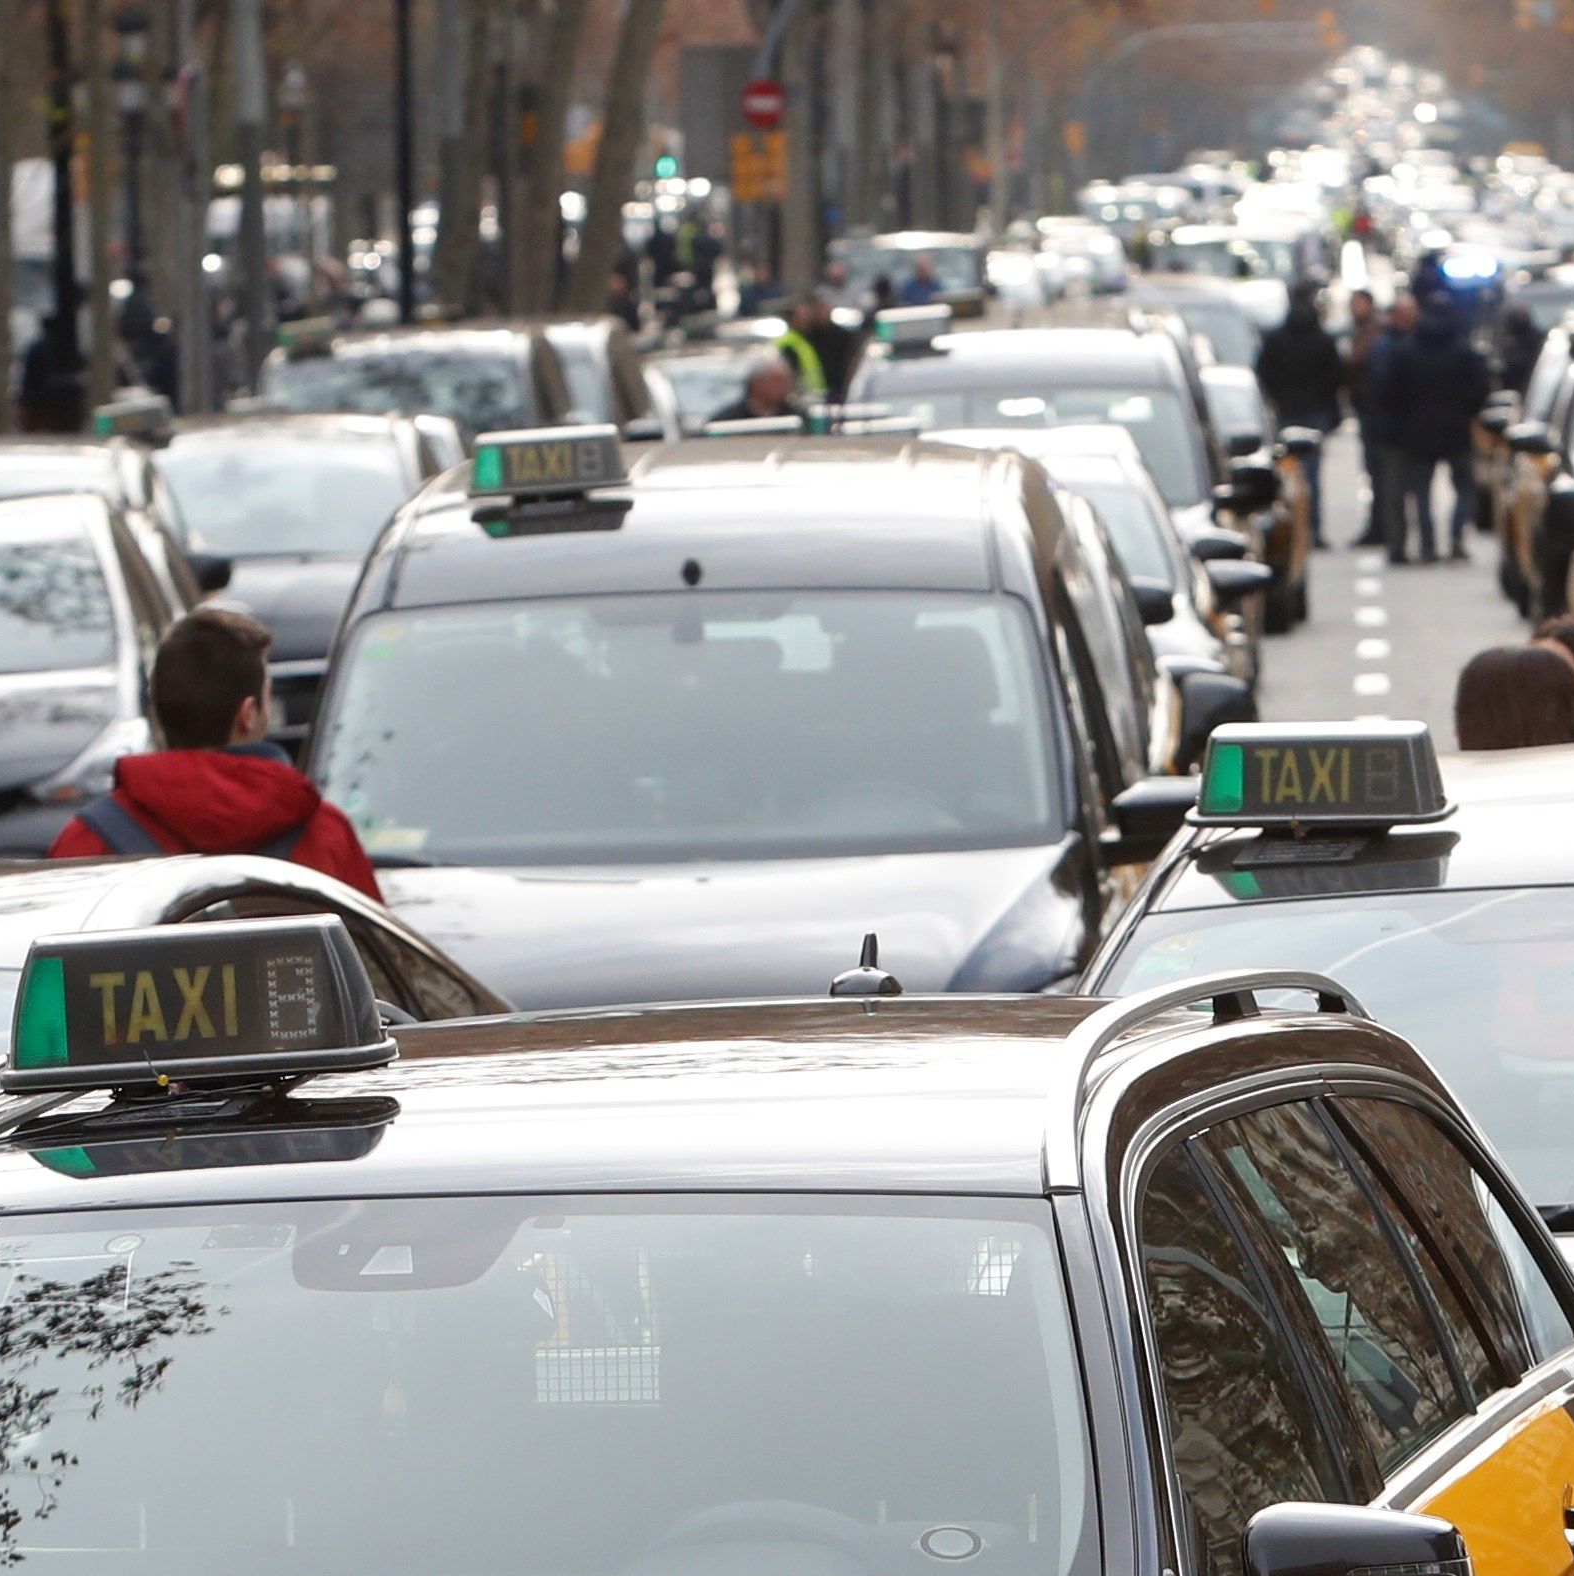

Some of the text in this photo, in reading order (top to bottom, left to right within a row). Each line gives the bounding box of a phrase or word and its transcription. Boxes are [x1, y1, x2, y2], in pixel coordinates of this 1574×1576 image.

[506, 443, 573, 480] TAXI
[1254, 747, 1352, 804] TAXI
[89, 963, 239, 1045] TAXI
